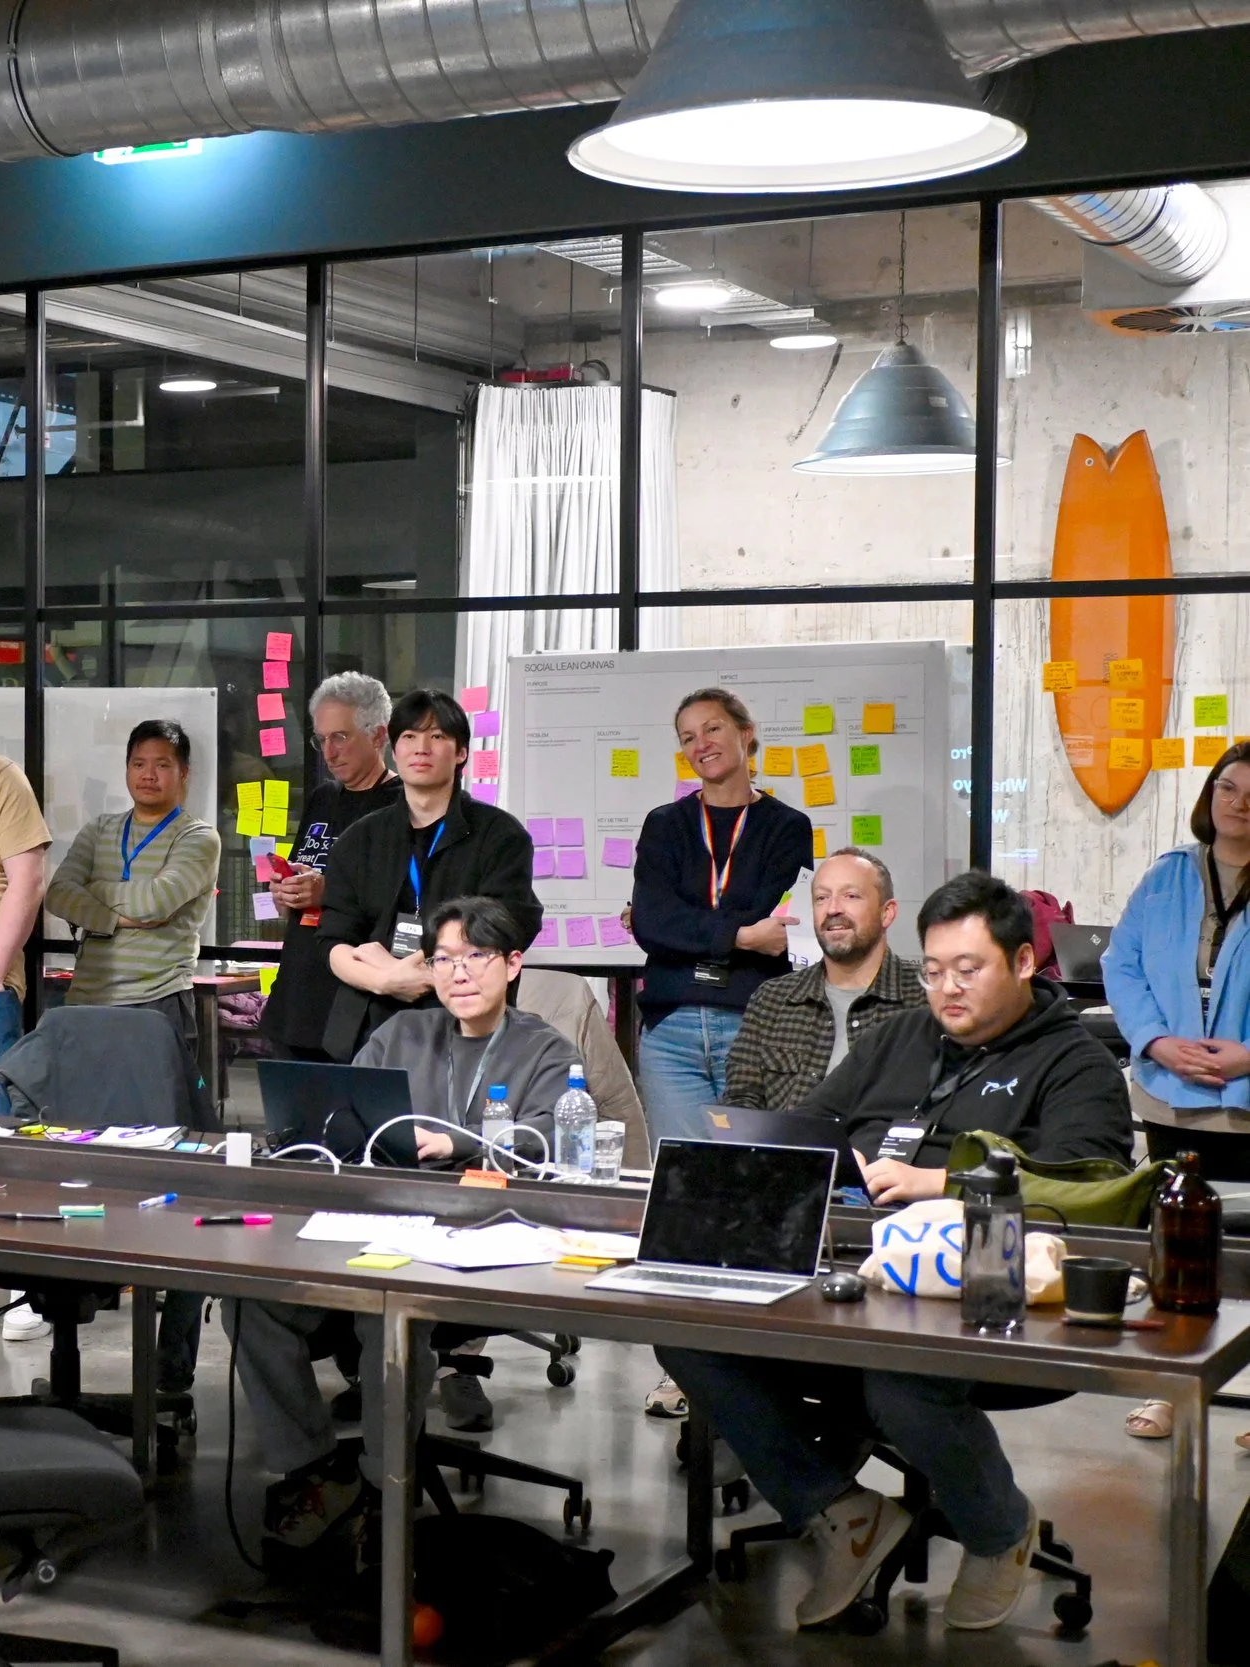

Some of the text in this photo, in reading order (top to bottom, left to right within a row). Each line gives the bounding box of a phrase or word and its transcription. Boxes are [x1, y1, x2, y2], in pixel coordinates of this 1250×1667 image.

[524, 660, 615, 672] SOCIAL LEAN CANVAS
